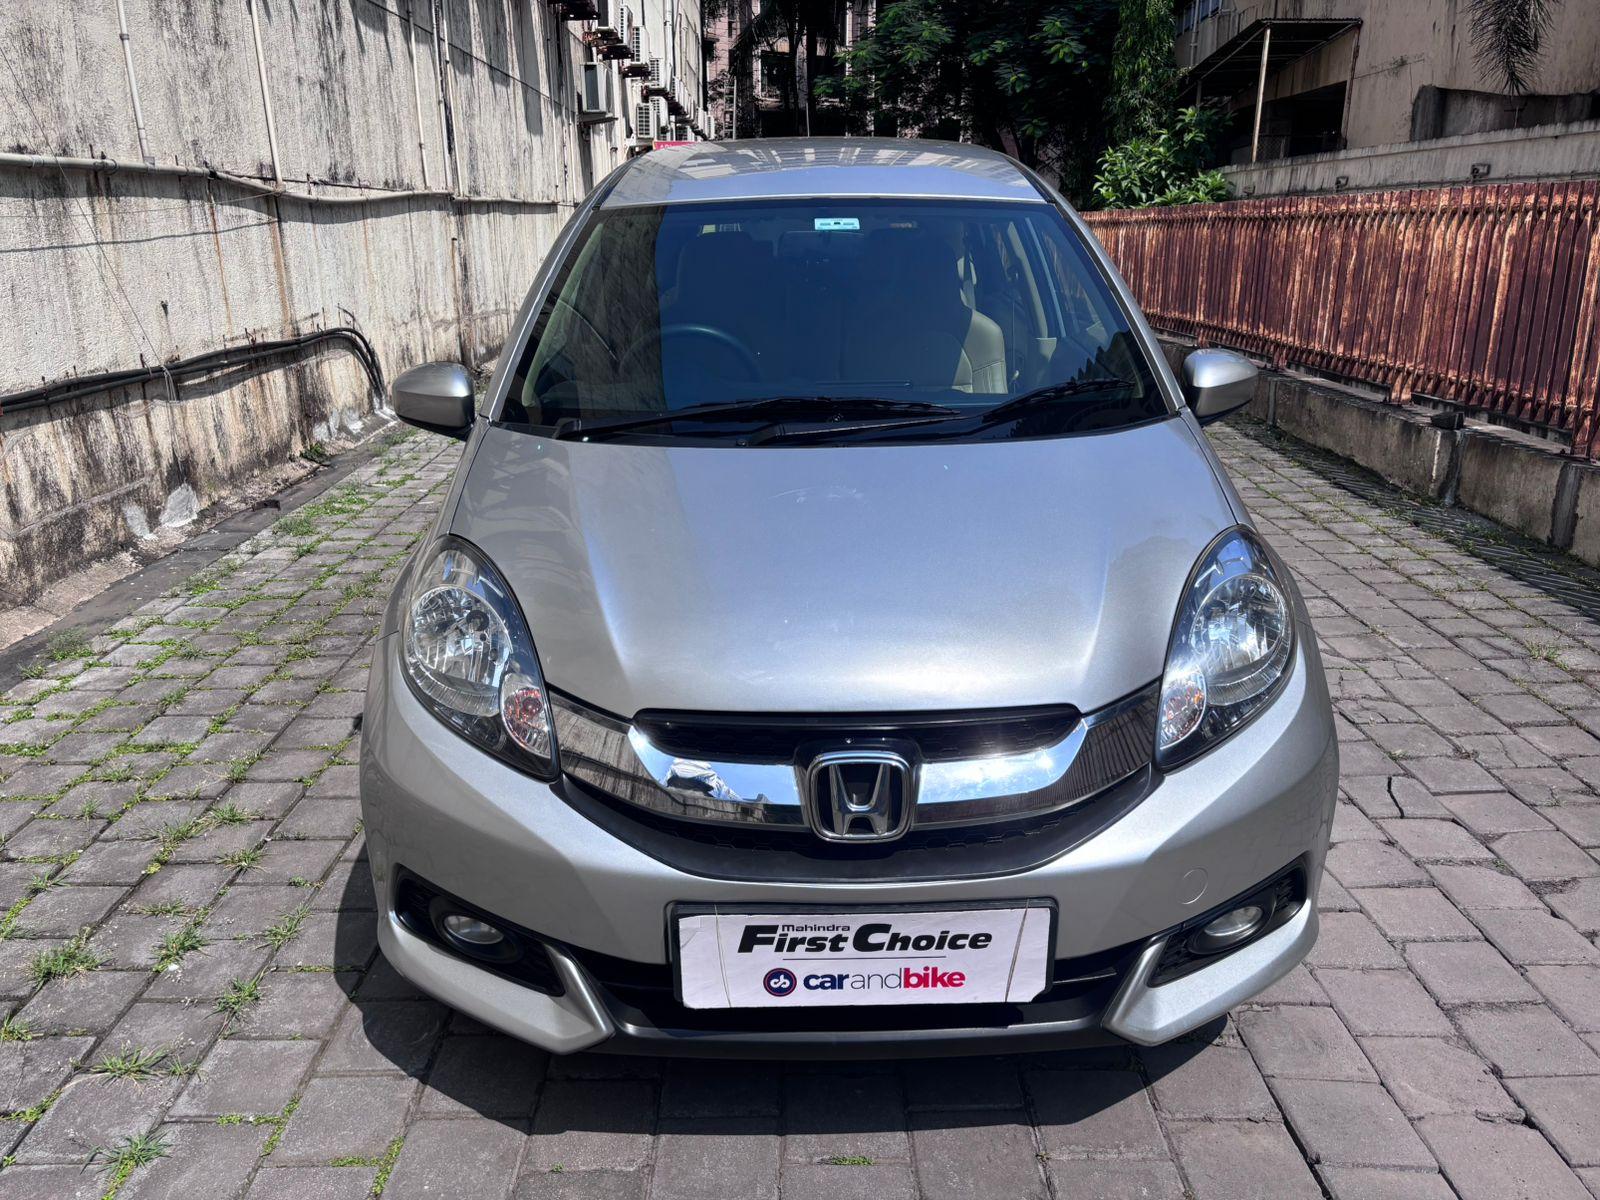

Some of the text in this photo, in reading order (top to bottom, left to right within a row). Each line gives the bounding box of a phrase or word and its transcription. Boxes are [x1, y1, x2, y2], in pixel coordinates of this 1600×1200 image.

[781, 924, 851, 932] Mahindra
[737, 923, 993, 953] First Choice
